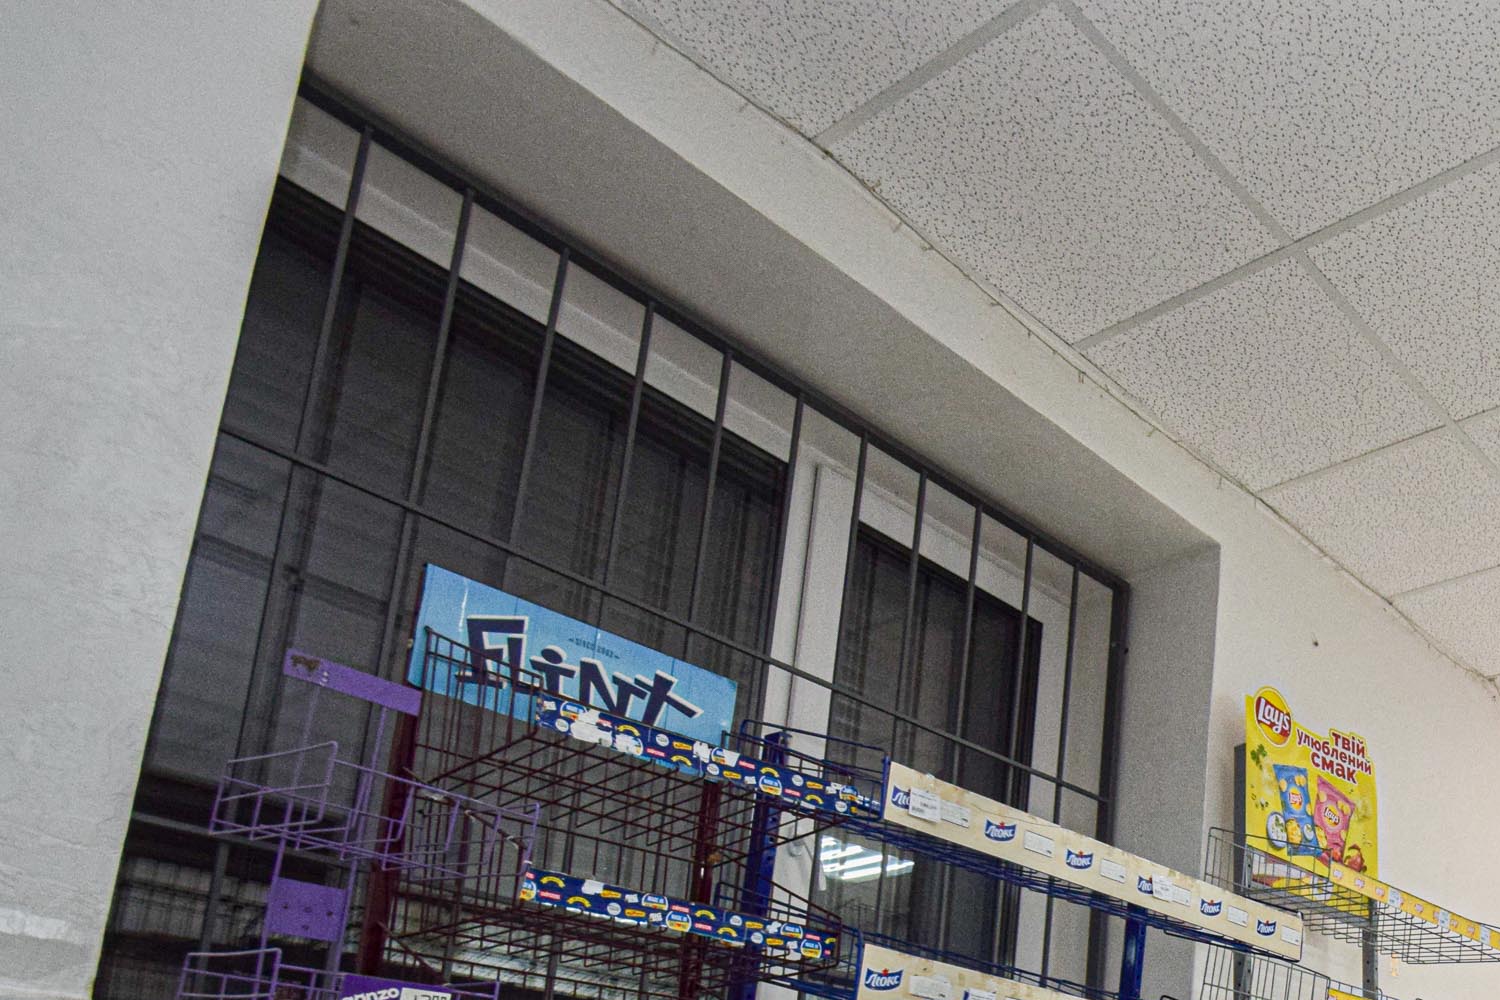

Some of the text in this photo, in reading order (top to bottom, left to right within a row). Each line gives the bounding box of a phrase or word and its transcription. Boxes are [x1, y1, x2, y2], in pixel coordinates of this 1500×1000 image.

[1296, 728, 1372, 775] улюблений
[1331, 732, 1366, 758] твій
[1310, 751, 1358, 785] смак
[864, 974, 900, 987] Люкс
